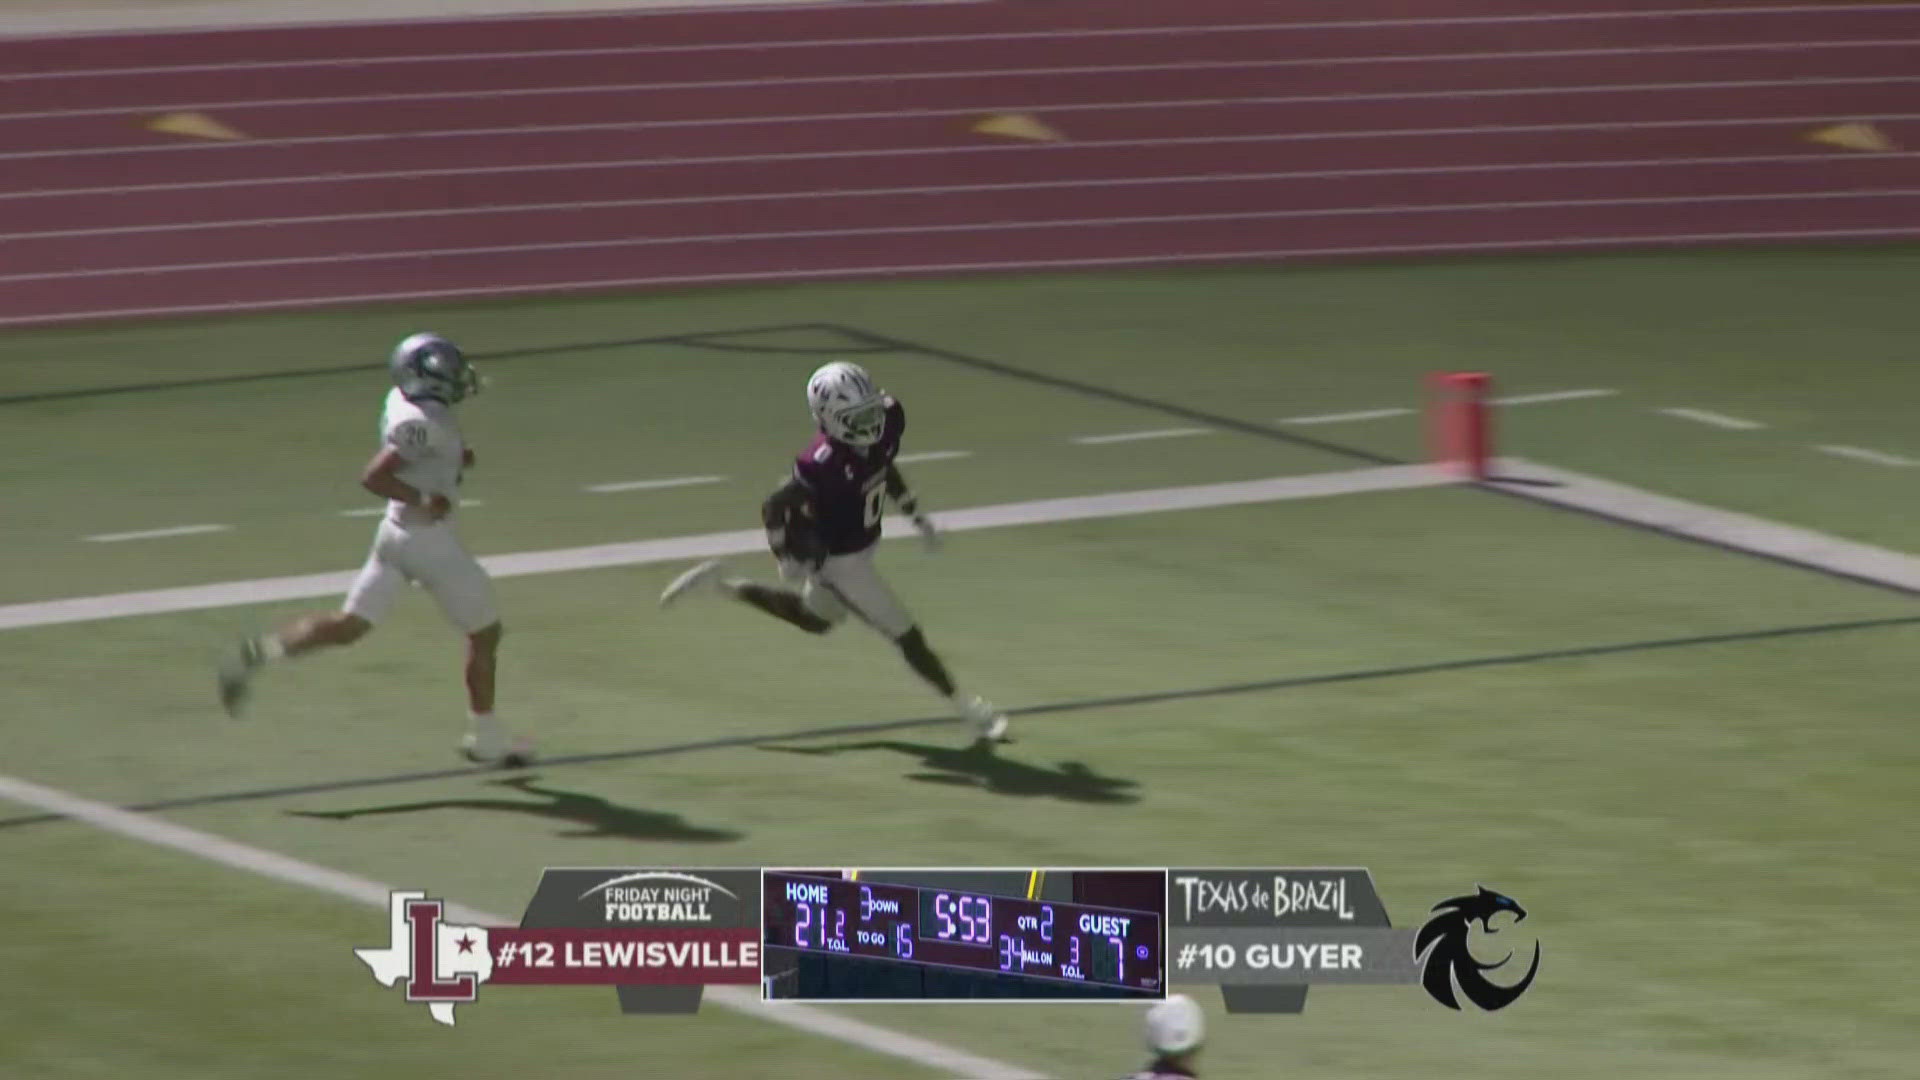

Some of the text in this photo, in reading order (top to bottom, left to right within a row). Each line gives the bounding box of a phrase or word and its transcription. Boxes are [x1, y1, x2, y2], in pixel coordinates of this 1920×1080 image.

[405, 427, 427, 446] 20
[864, 480, 887, 529] 0
[786, 882, 828, 903] HOME
[860, 886, 899, 920] 3 DOWN
[795, 903, 827, 947] 21
[836, 910, 846, 938] 2
[935, 894, 990, 943] 5:53
[1017, 905, 1054, 943] QTR 2
[1079, 914, 1130, 937] GUEST
[857, 923, 913, 959] TO GO 15
[1000, 934, 1053, 972] 34 BALL ON
[1070, 936, 1080, 965] 3
[1109, 937, 1124, 983] 7
